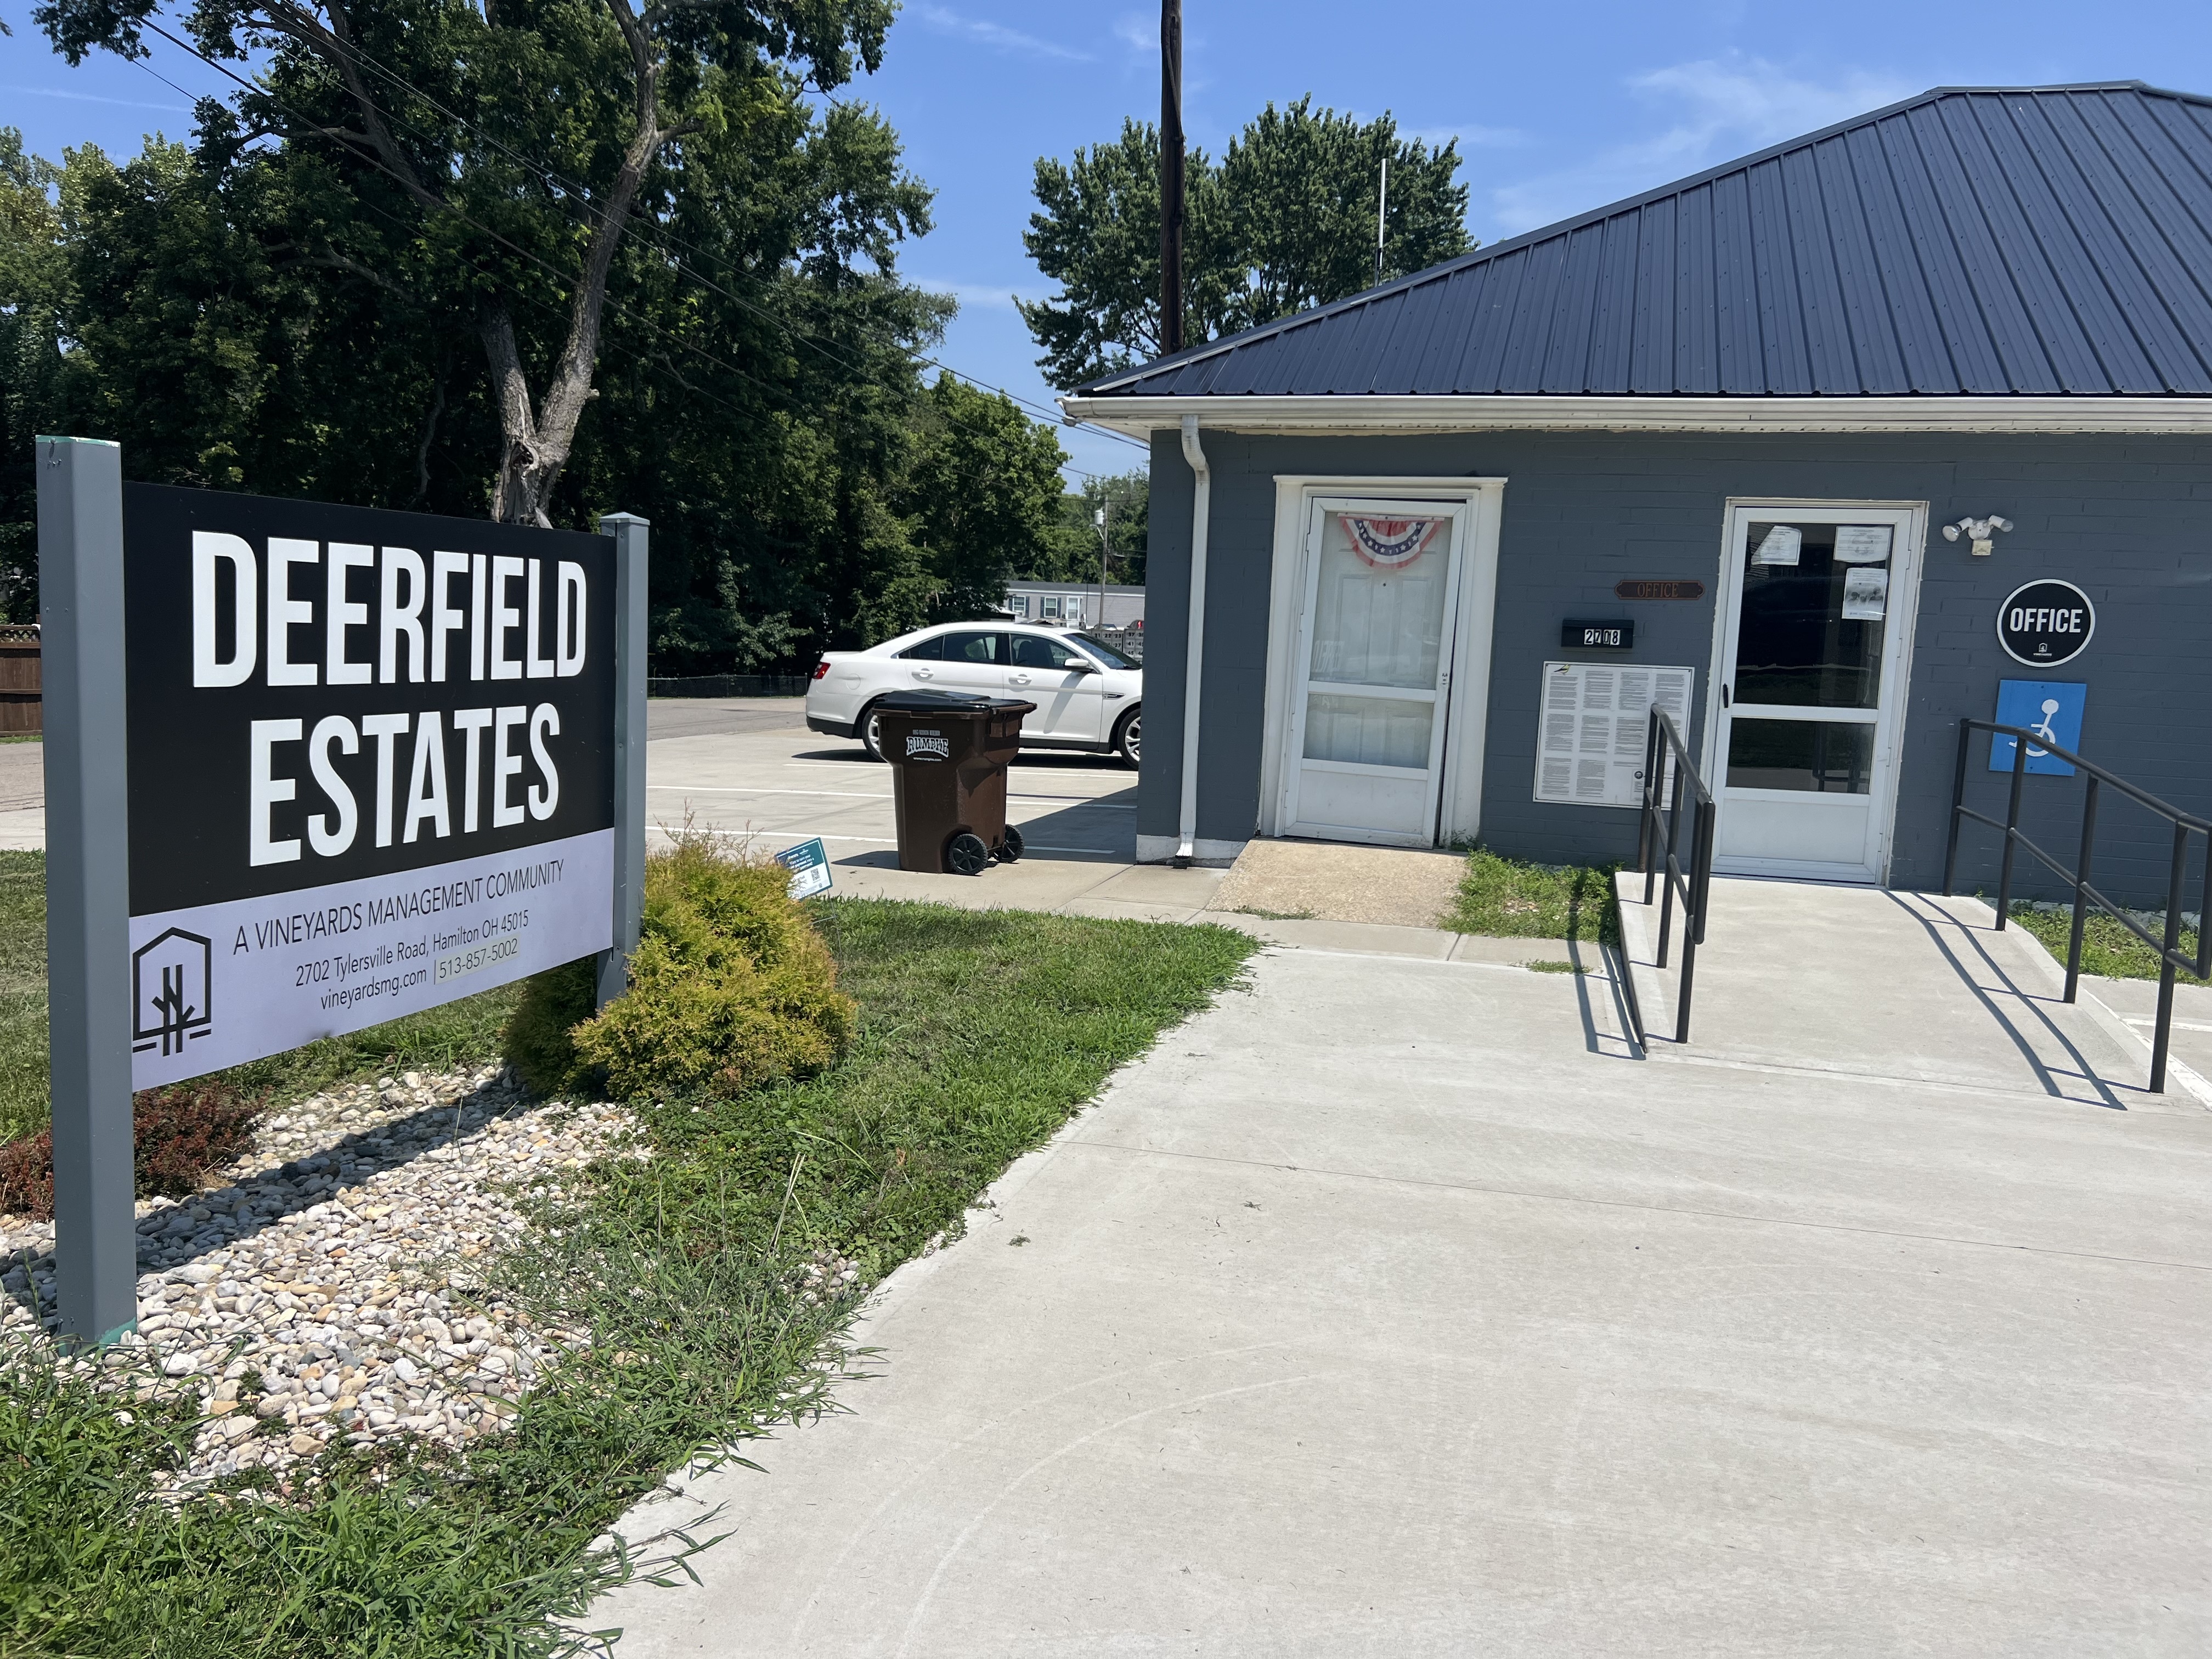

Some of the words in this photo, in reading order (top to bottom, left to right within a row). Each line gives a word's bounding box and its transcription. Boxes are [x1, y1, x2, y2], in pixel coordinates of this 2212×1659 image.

[192, 531, 586, 688] DEERFIELD
[1637, 583, 1679, 597] OFFICE
[1585, 629, 1620, 645] 2708
[2010, 607, 2083, 633] OFFICE
[906, 736, 949, 758] RUMPKE
[250, 703, 560, 867] ESTATES
[233, 926, 250, 955] A
[255, 902, 362, 950] VINEYARDS
[368, 878, 483, 927] MANAGEMENT
[486, 859, 564, 899] COMMUNITY
[296, 960, 330, 987] 2702
[334, 945, 393, 982] Tylersville
[397, 935, 428, 962] Road,
[433, 926, 479, 952] Hamilton
[482, 917, 498, 938] OH
[501, 909, 529, 933] 45015
[321, 968, 427, 1010] vineyardsmg.com
